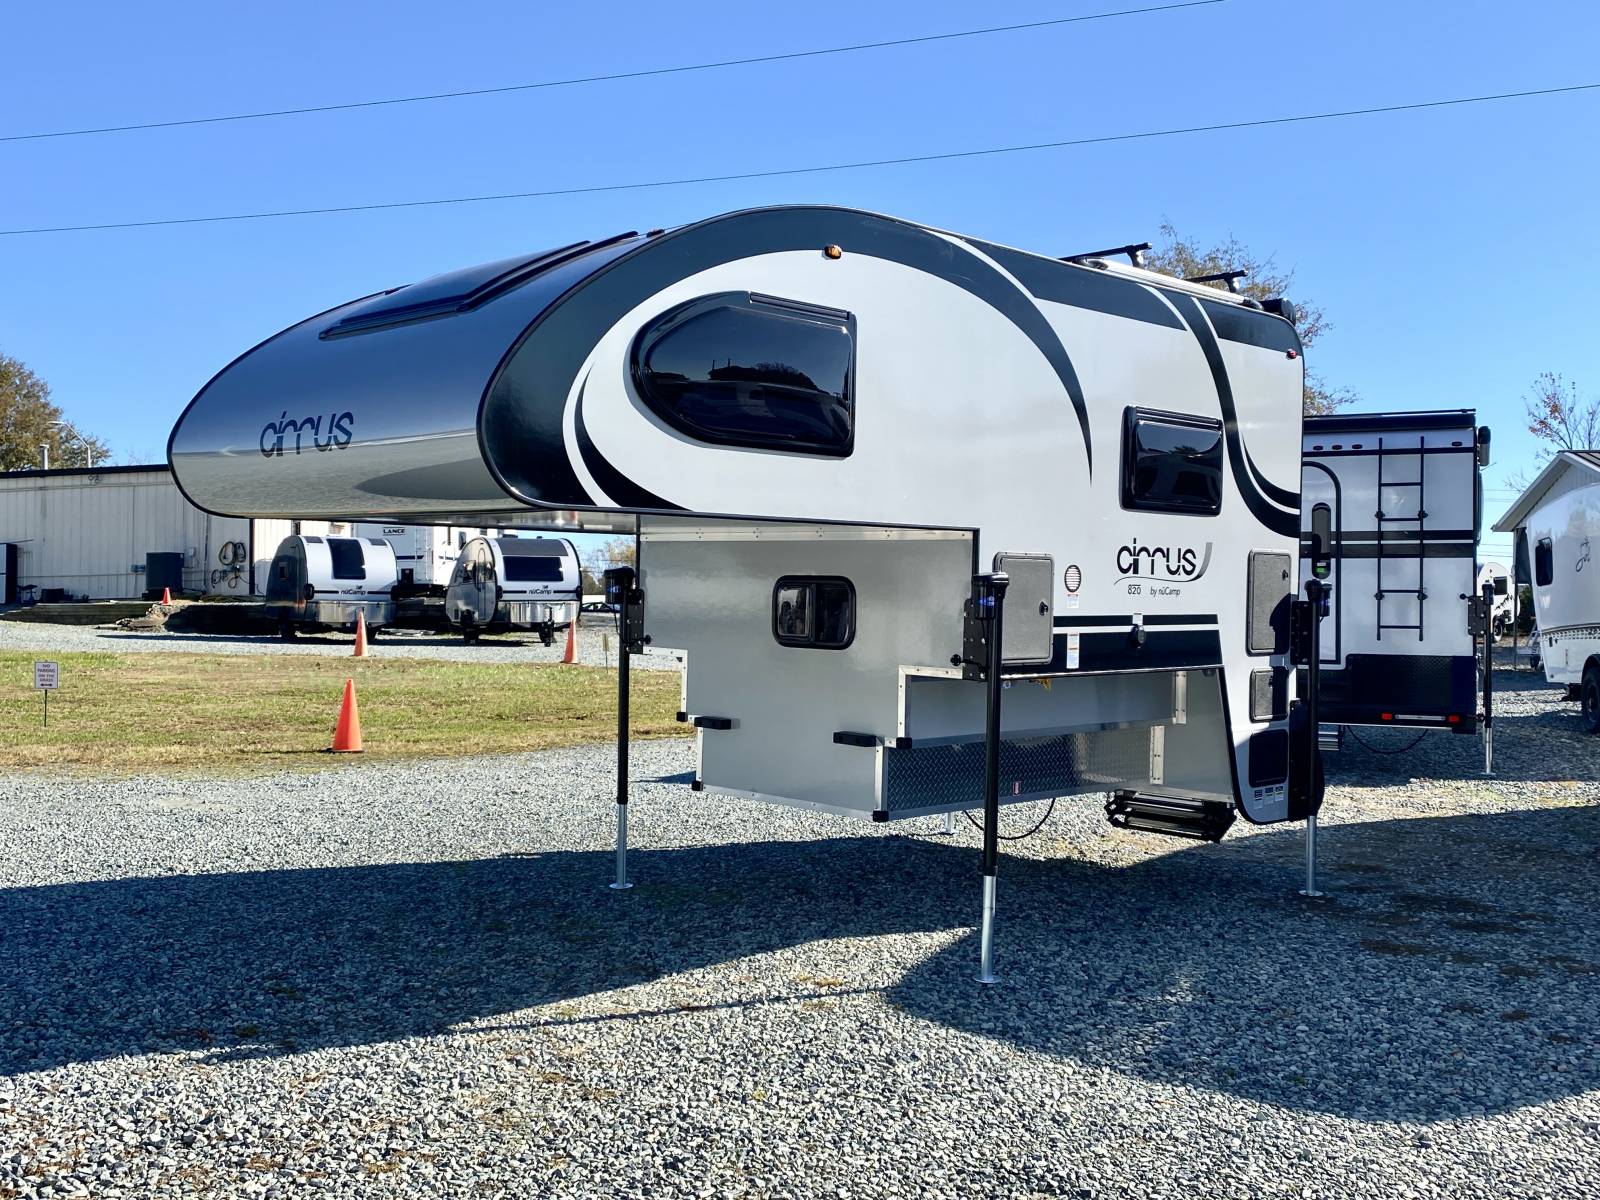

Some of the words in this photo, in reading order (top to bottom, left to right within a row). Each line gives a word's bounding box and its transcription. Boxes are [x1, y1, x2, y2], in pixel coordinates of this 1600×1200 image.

[260, 411, 354, 458] cirrus
[1116, 538, 1197, 576] cirrus
[1127, 584, 1142, 595] 820
[1150, 586, 1158, 598] by
